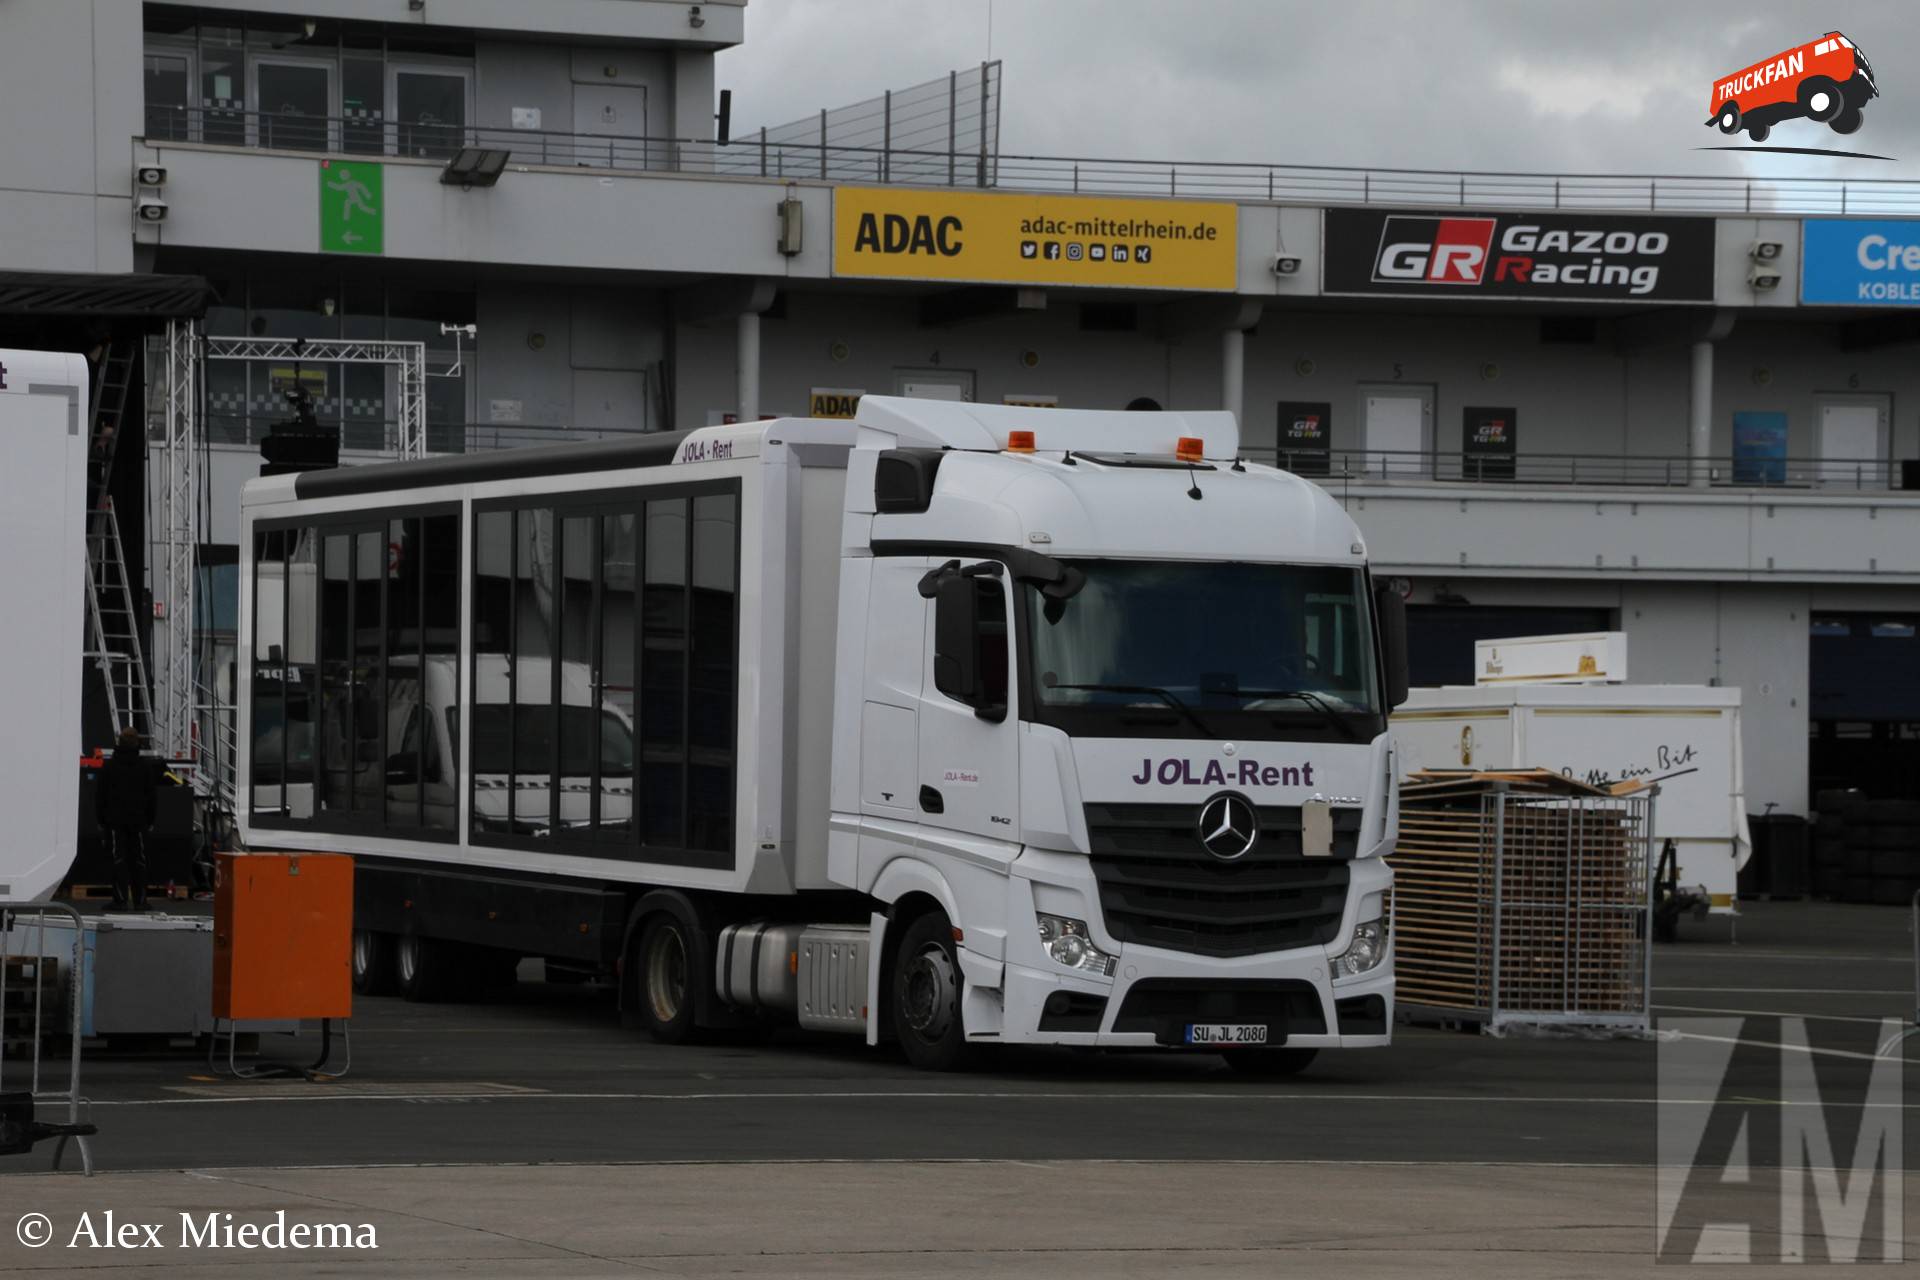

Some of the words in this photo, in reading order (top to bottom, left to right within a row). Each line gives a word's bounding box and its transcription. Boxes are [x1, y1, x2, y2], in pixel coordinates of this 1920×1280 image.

[854, 213, 963, 256] ADAC
[1020, 218, 1217, 240] adac-mittelrhein.de
[1501, 225, 1669, 256] GAZOO
[1379, 243, 1486, 281] GR
[1857, 234, 1920, 271] Cre
[1494, 256, 1659, 294] Racing
[1859, 283, 1920, 300] KOBLE
[929, 350, 941, 365] 4
[1393, 363, 1403, 379] 5
[1848, 373, 1859, 388] 6
[682, 441, 705, 462] JOLA
[712, 440, 732, 459] Rent
[1132, 759, 1314, 786] JOLA-Rent
[1621, 763, 1652, 779] ein
[1657, 745, 1698, 770] Bit
[1193, 1027, 1210, 1041] SU
[1218, 1027, 1233, 1041] JL
[1236, 1027, 1266, 1041] 2080
